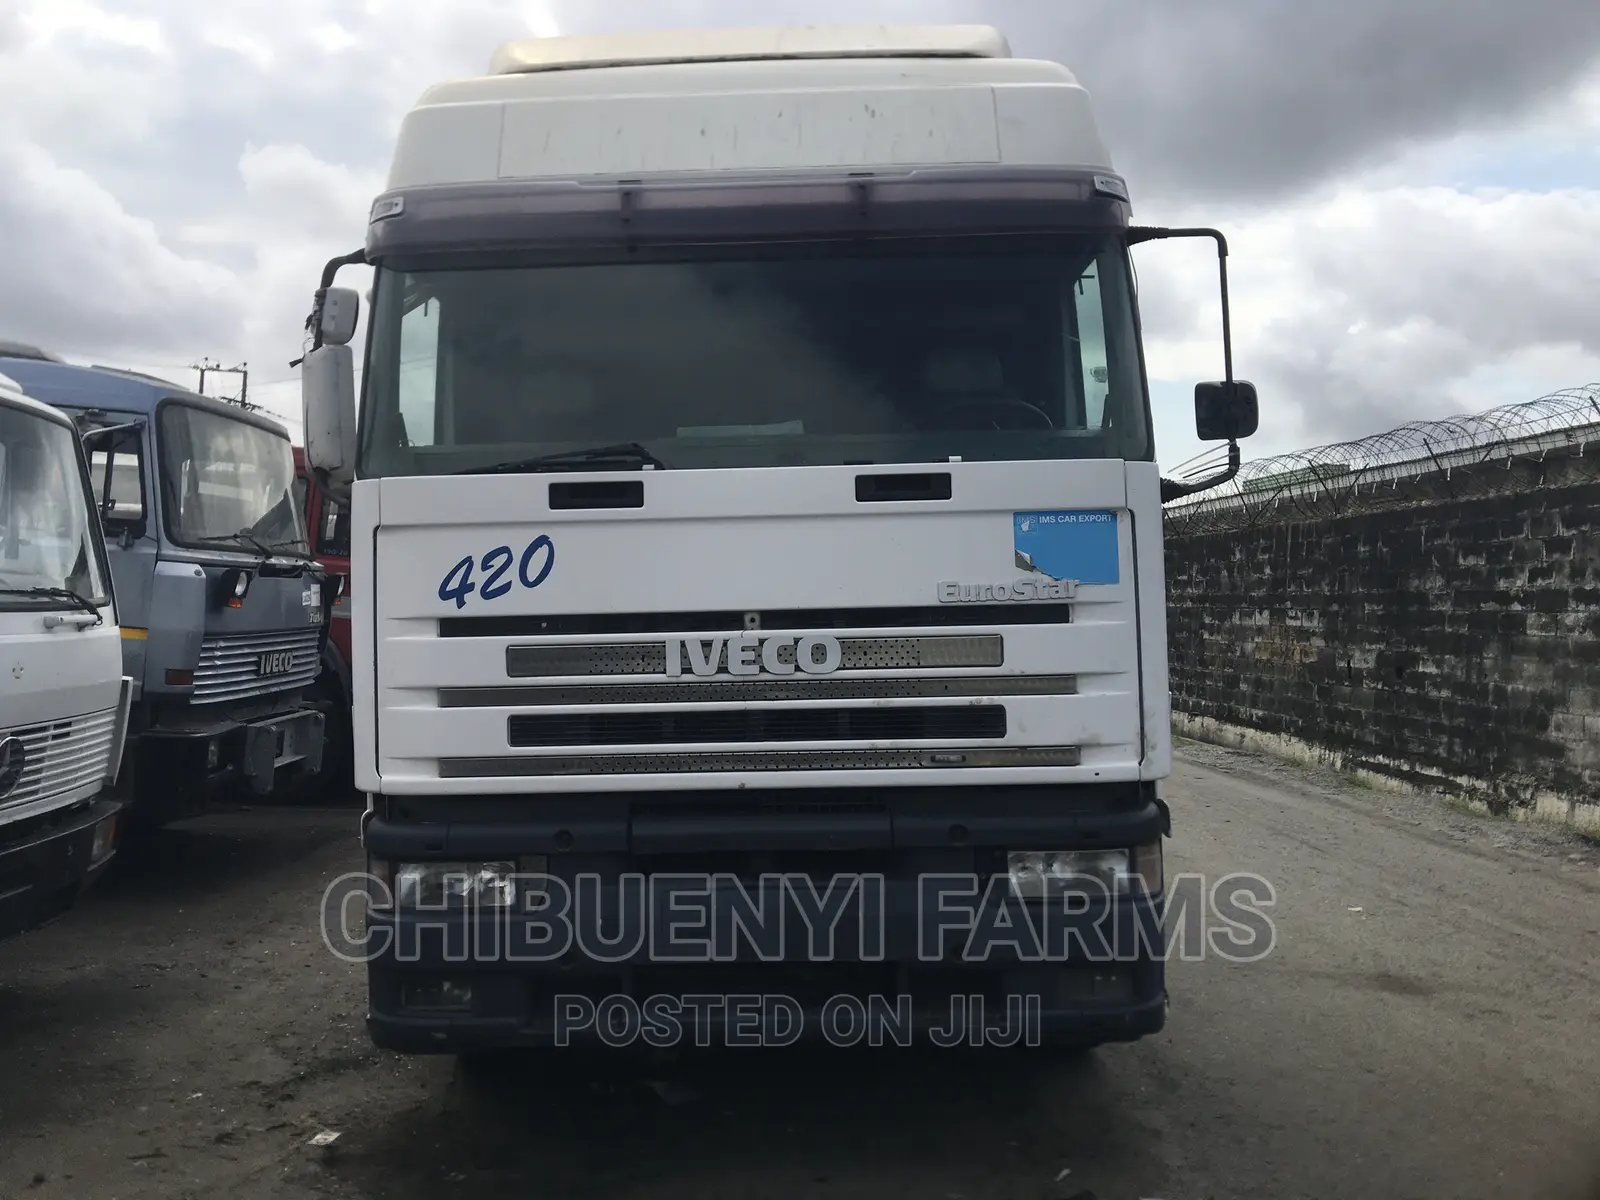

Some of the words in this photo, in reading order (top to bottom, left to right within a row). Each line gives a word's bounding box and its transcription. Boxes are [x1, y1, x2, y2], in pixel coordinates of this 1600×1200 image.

[1039, 515, 1055, 524] IMS
[1057, 514, 1077, 524] CAR
[1078, 513, 1112, 523] EXPORT
[438, 534, 555, 609] 420
[937, 578, 1080, 603] EuroStar
[260, 651, 293, 675] IVECO
[665, 634, 842, 677] IVECO
